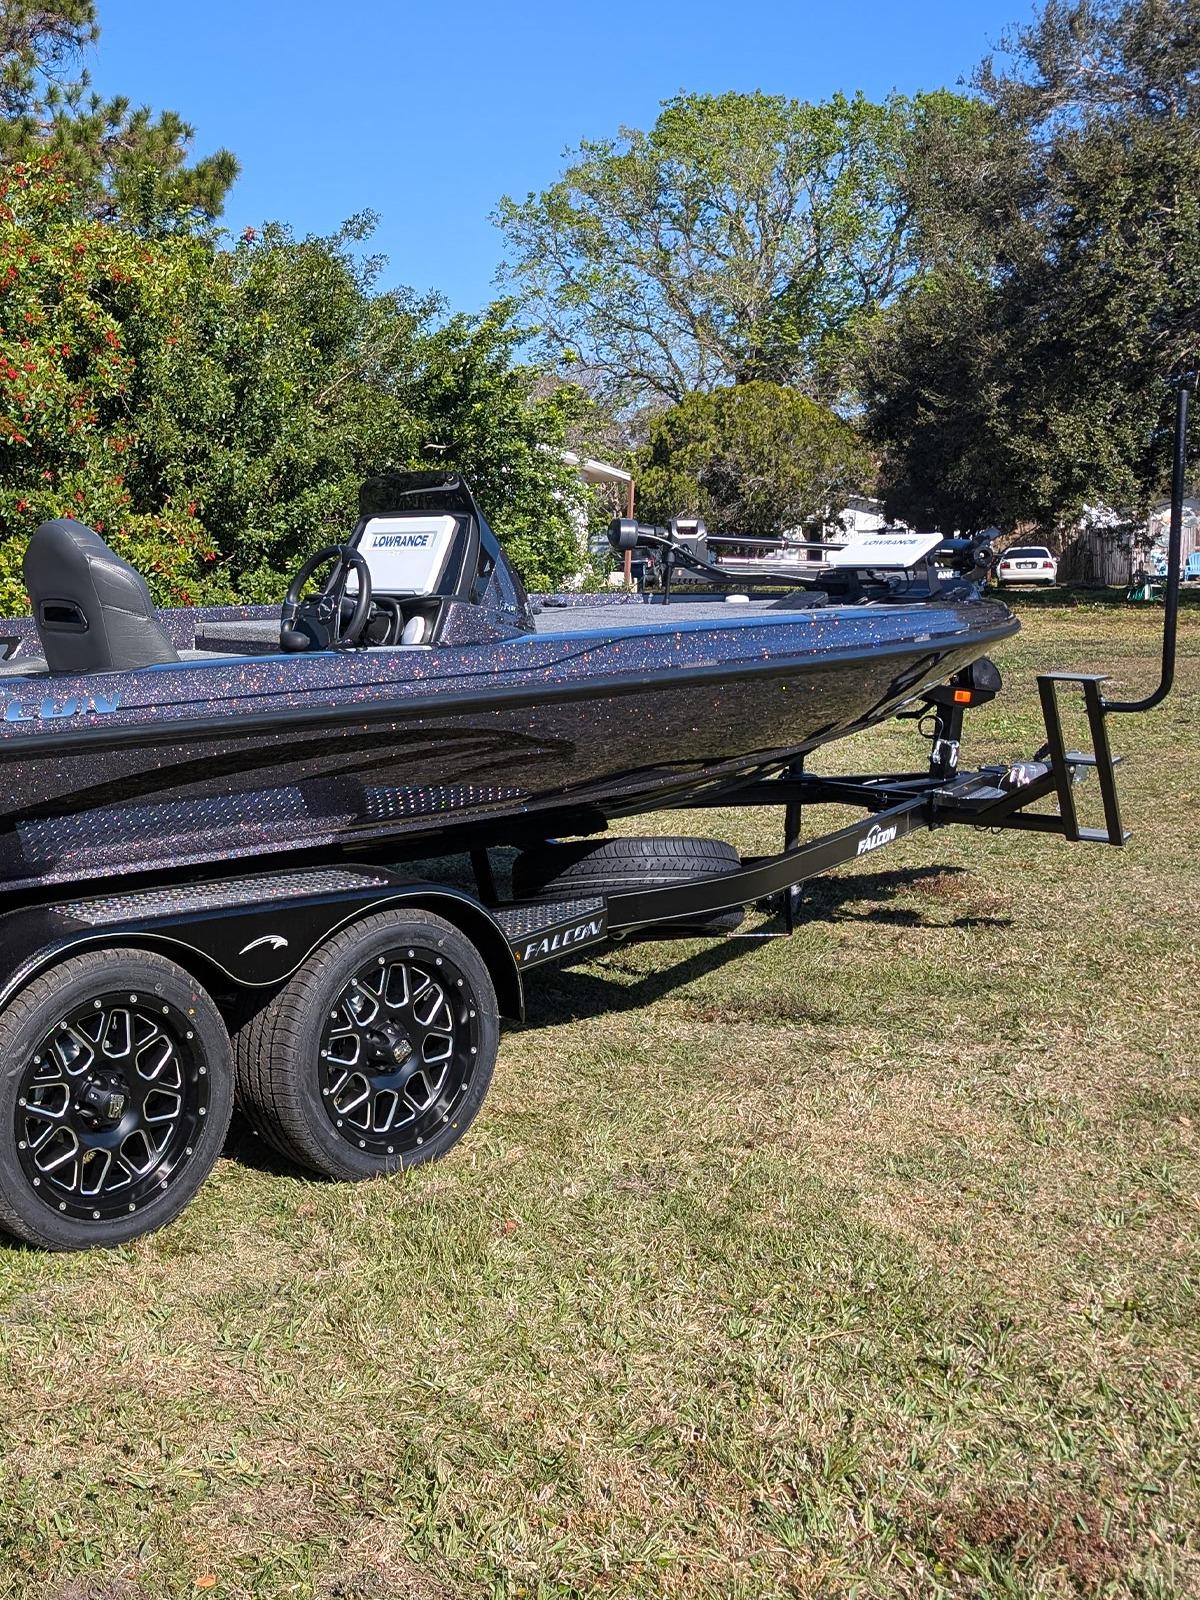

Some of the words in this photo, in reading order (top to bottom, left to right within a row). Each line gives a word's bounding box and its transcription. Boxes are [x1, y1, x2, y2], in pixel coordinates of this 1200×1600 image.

[372, 534, 428, 547] LOWRANCE
[863, 538, 917, 546] LOWRANCE
[937, 570, 961, 580] ANCE
[858, 826, 897, 856] FALCON
[523, 919, 603, 961] FALCON
